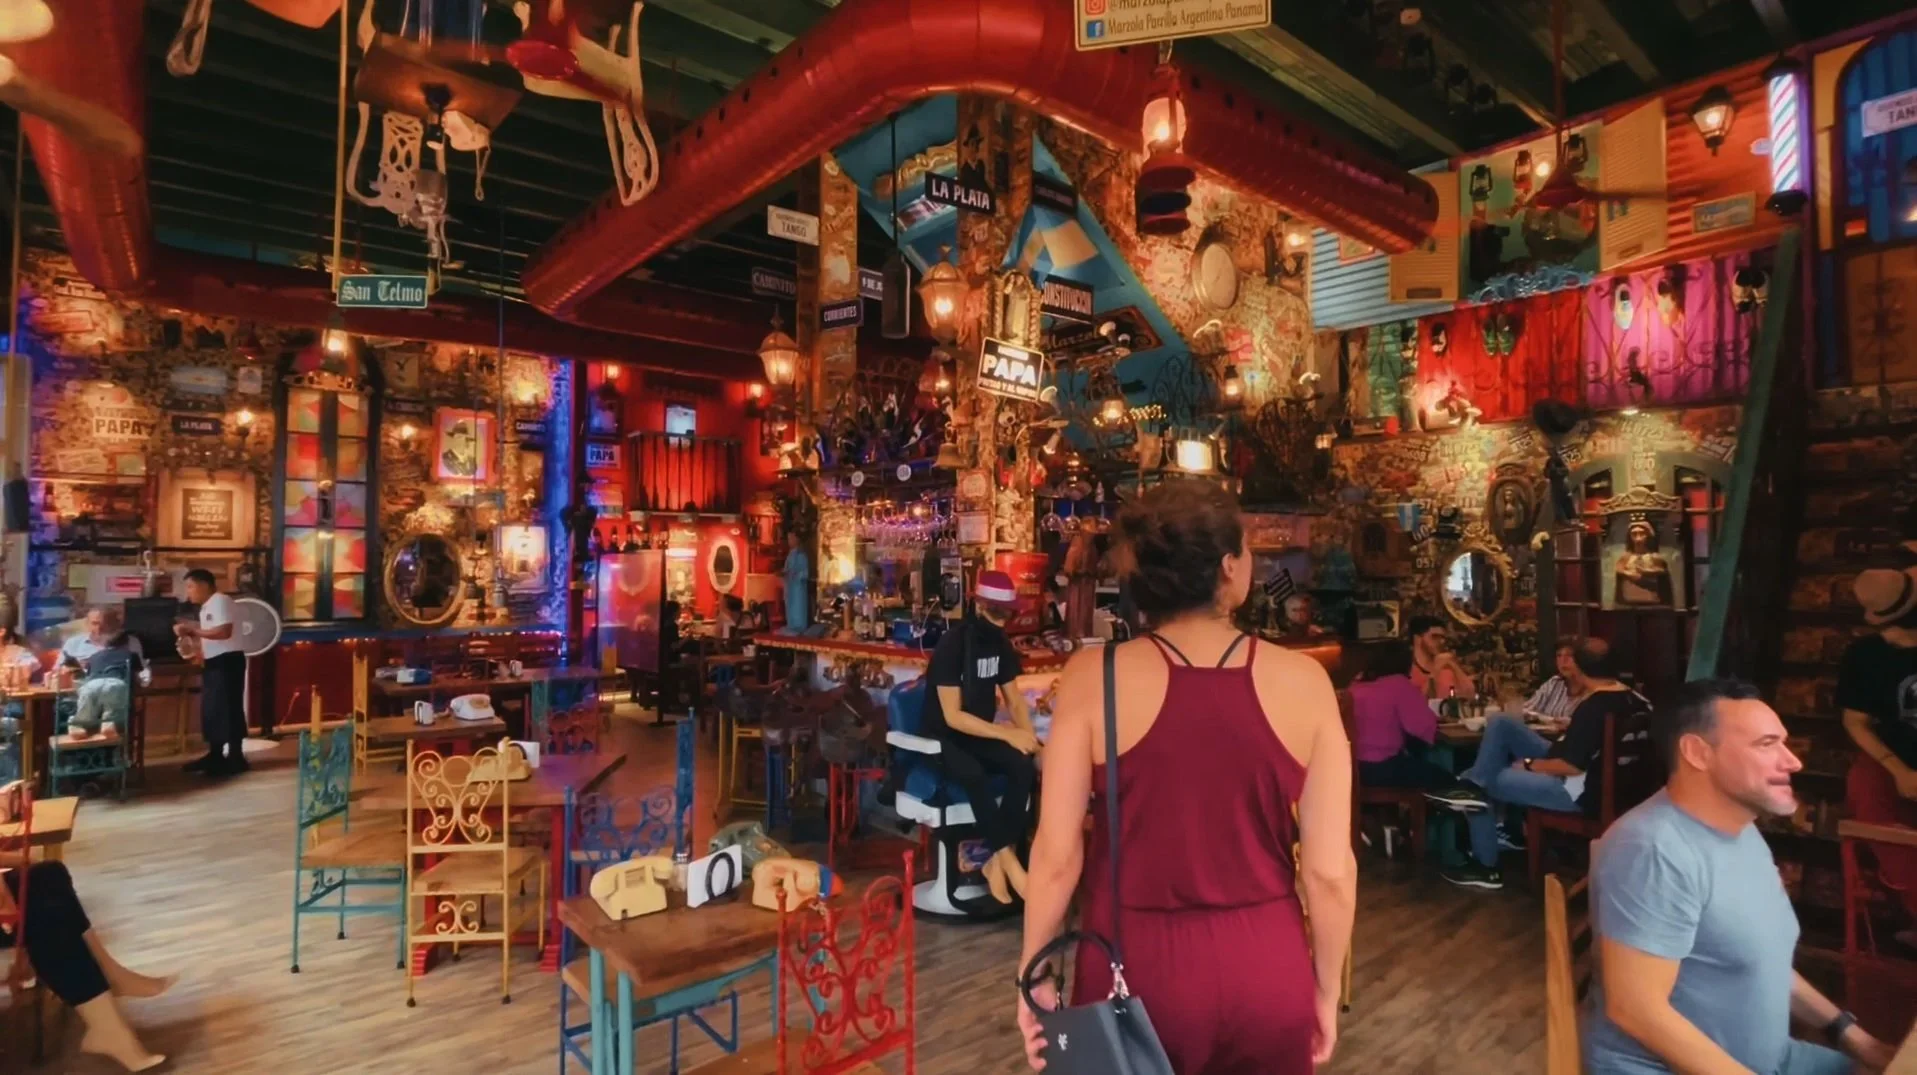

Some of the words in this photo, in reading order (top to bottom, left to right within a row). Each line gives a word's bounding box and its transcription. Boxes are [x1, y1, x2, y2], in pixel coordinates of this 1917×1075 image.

[1108, 14, 1144, 35] Marzola
[1146, 12, 1177, 30] Parrilla
[1180, 7, 1224, 29] Argentina
[1888, 104, 1917, 124] TAN
[931, 178, 949, 199] LA
[953, 183, 990, 211] PLATA
[782, 220, 807, 238] TANGO
[341, 280, 371, 301] San
[377, 280, 423, 302] Telmo
[982, 353, 1037, 387] PAPA
[94, 418, 145, 435] PAPA
